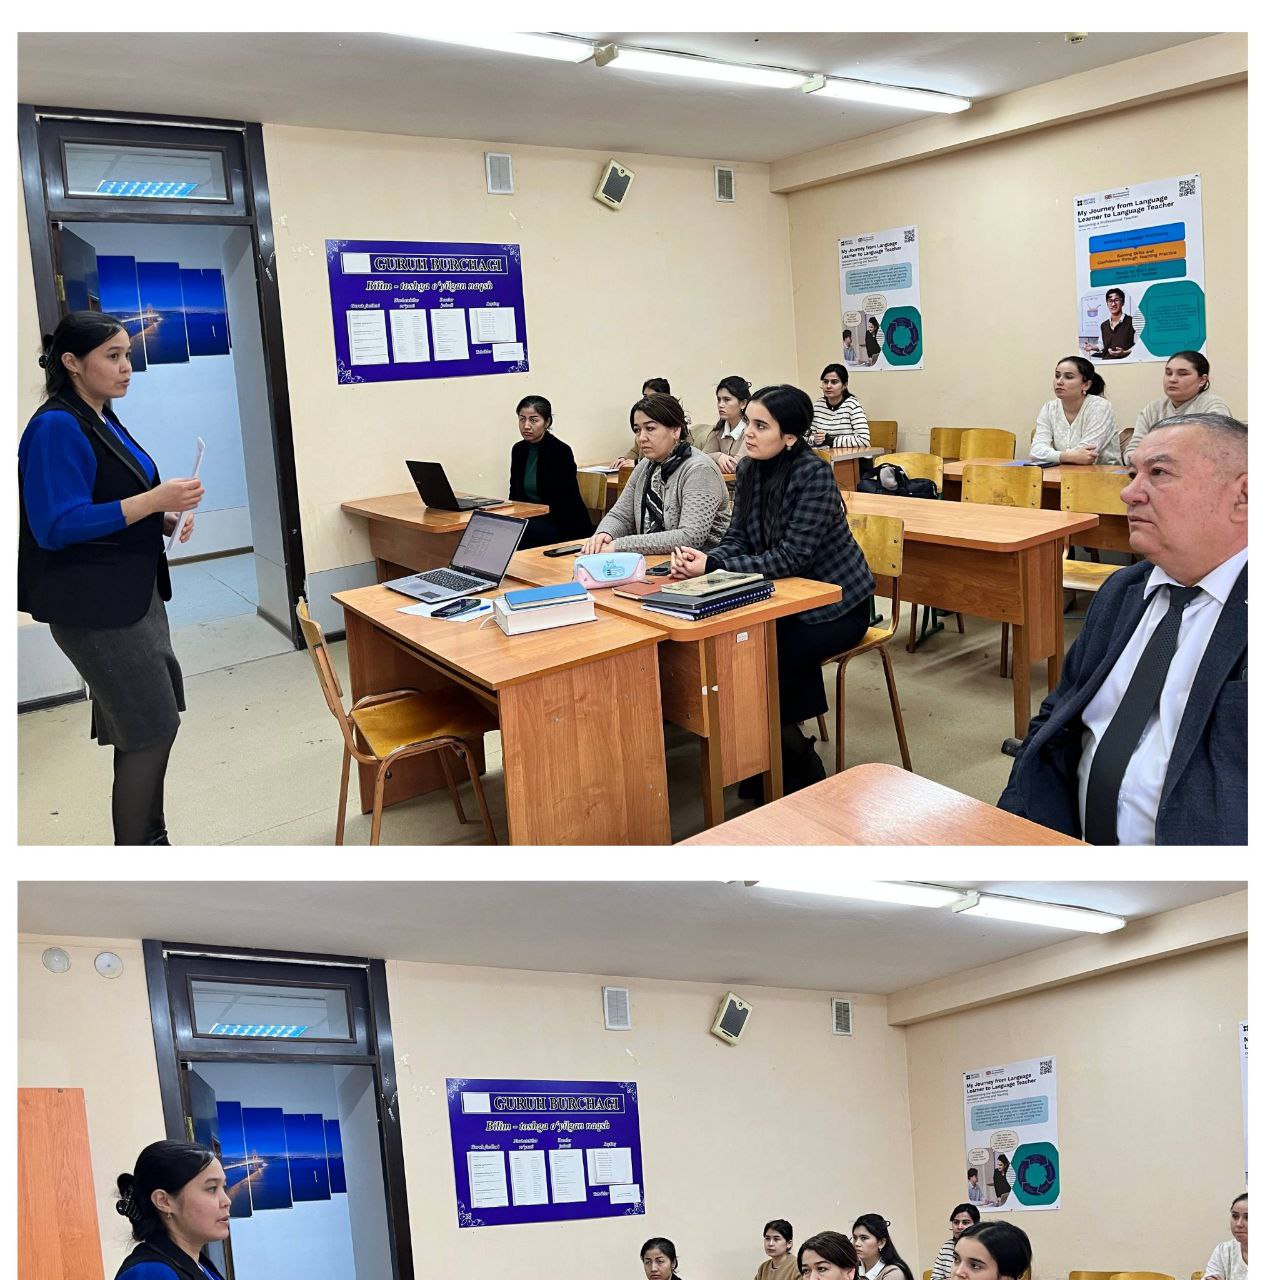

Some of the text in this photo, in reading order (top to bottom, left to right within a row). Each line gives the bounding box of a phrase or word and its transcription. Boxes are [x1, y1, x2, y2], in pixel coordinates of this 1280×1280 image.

[1077, 210, 1087, 218] My
[1089, 205, 1115, 216] Journey
[1135, 195, 1168, 207] Language
[1077, 214, 1103, 223] Learner
[1113, 206, 1145, 218] Language
[1146, 201, 1175, 211] Teacher
[877, 241, 897, 249] Language
[374, 257, 502, 272] GURUH BURCHAGI
[366, 281, 392, 291] Bilim
[400, 281, 430, 292] toshga
[468, 281, 493, 292] naqsh
[1008, 1073, 1031, 1081] Language
[1017, 1078, 1036, 1086] Teacher
[494, 1096, 619, 1111] GURUH BURCHAGI
[486, 1121, 511, 1131] Bilim
[518, 1121, 549, 1133] toshga
[585, 1121, 610, 1132] naqsh
